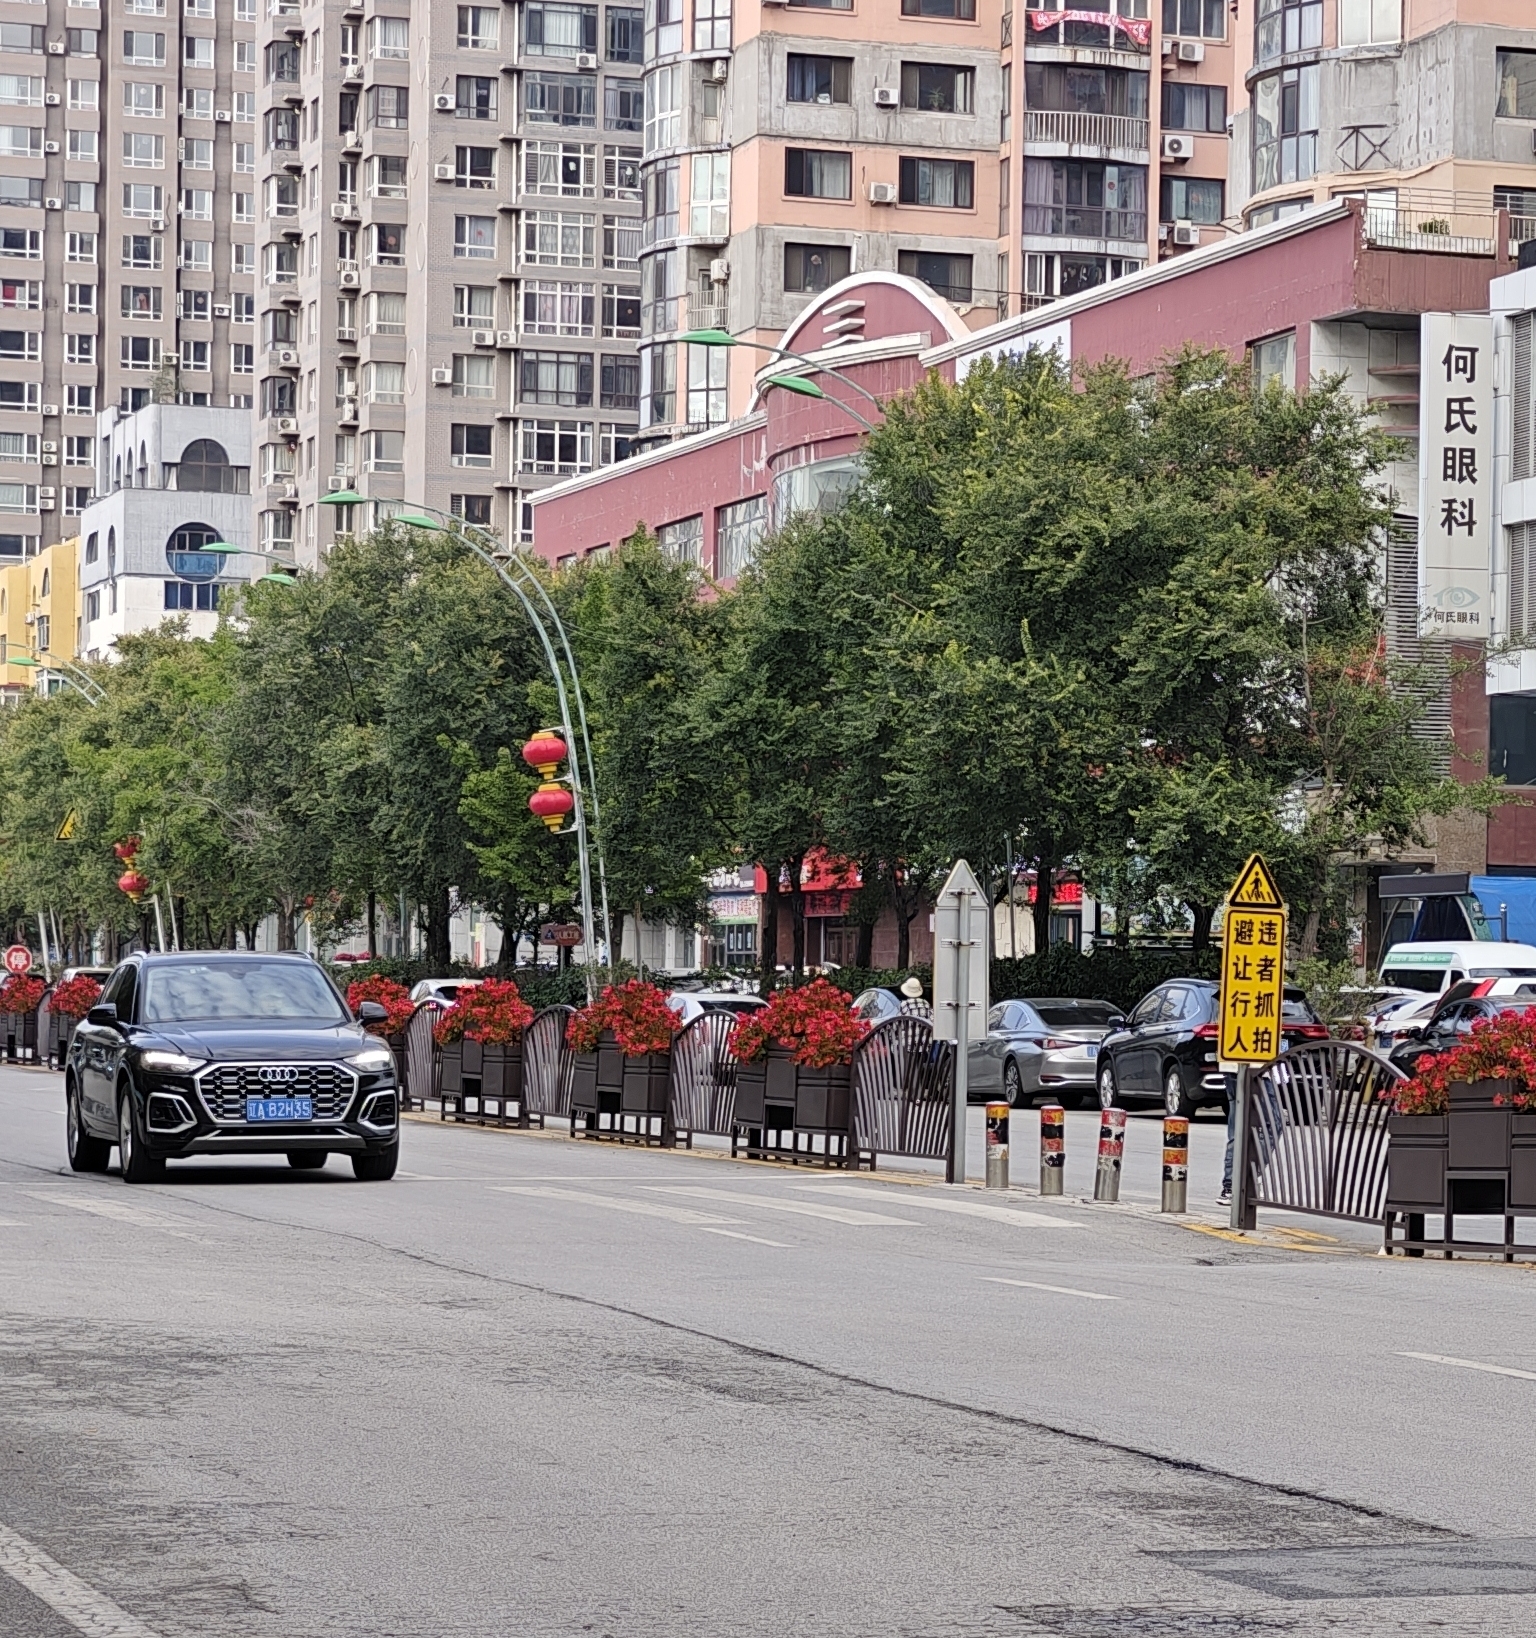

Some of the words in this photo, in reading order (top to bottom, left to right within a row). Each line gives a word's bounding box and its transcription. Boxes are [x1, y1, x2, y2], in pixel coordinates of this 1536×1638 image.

[1440, 343, 1480, 538] 何氏眼科
[1434, 611, 1480, 624] 何氏眼科
[1228, 918, 1255, 1053] 避让行人
[1252, 919, 1279, 1054] 违者抓拍
